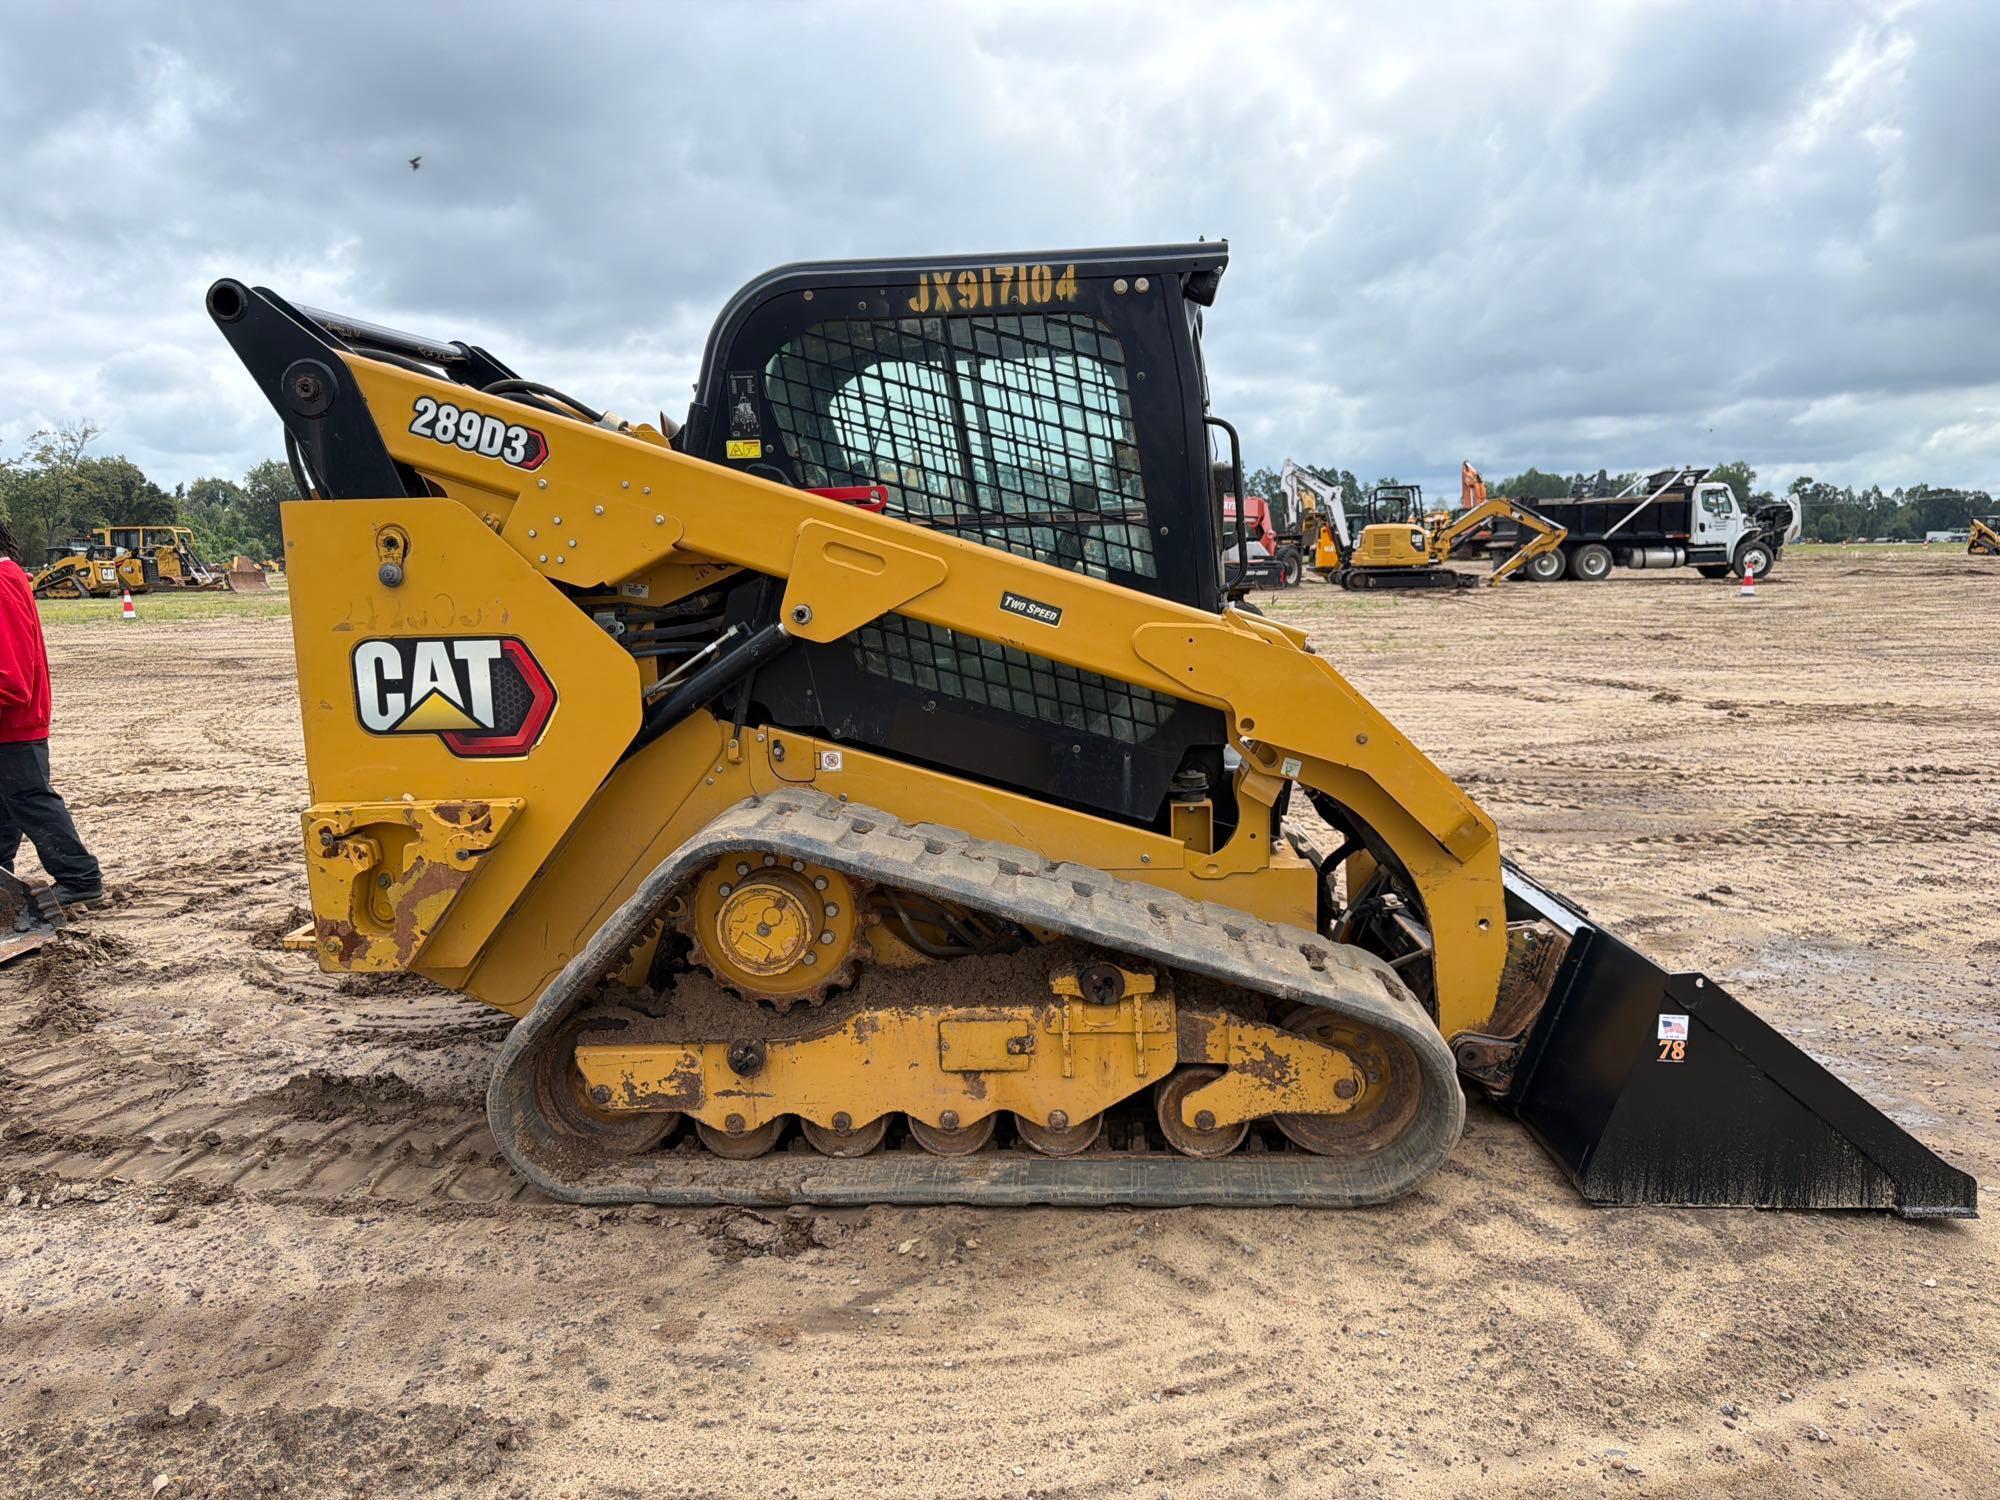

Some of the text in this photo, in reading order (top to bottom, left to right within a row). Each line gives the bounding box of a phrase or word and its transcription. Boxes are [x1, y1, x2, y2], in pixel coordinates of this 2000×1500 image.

[908, 264, 1078, 313] JX917104
[411, 397, 528, 464] 289D3
[102, 569, 114, 580] CAT
[355, 639, 502, 731] CAT
